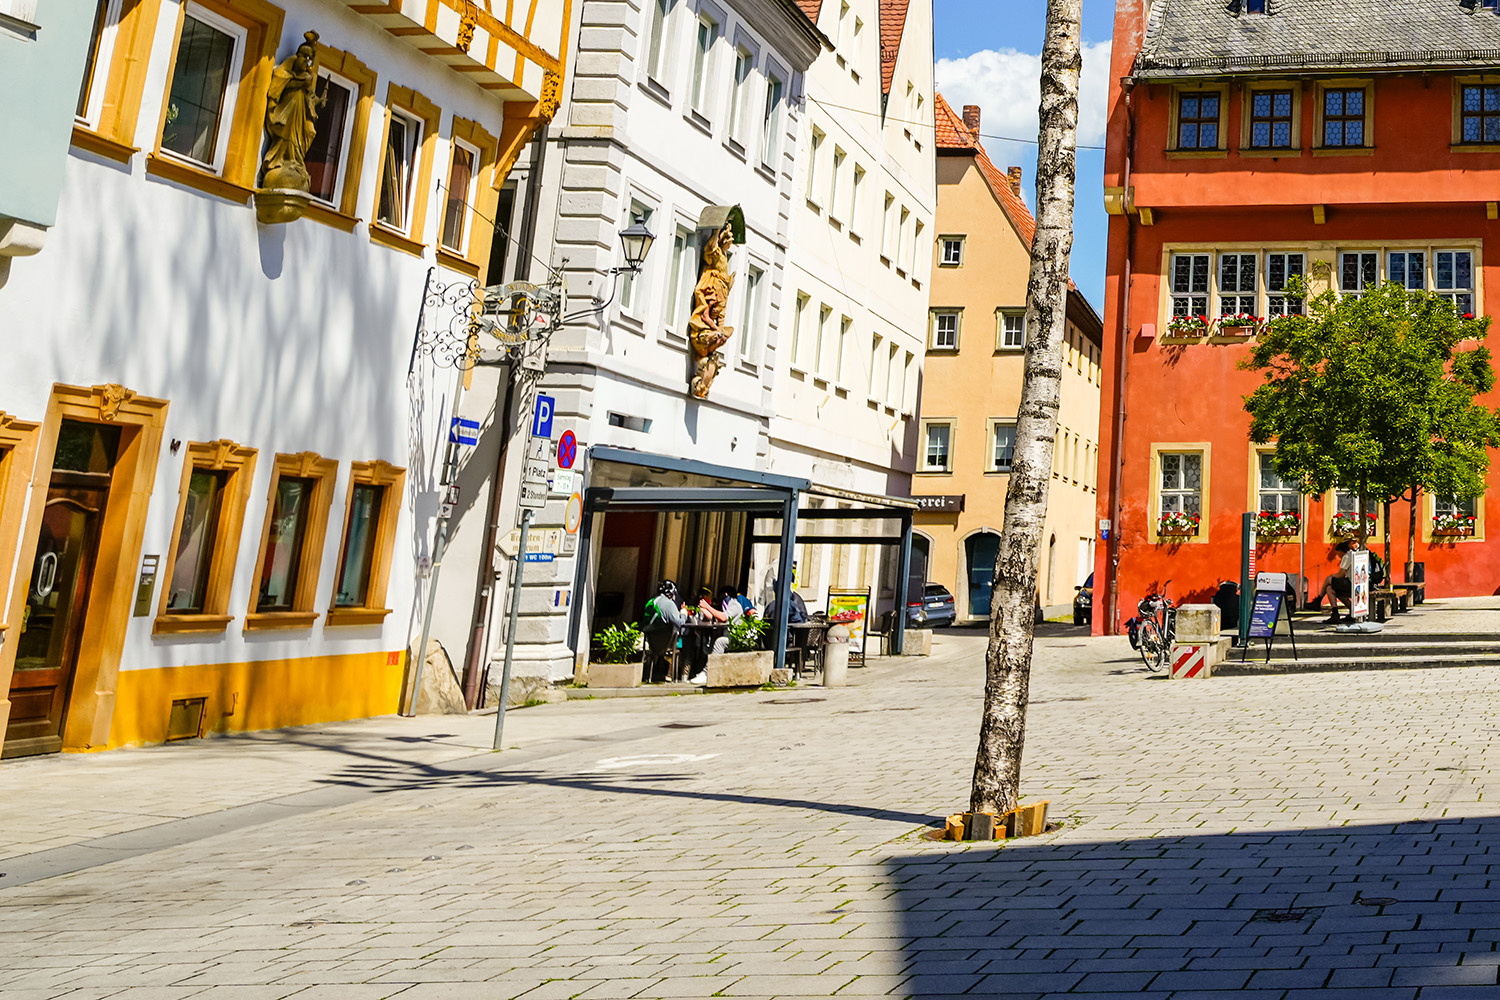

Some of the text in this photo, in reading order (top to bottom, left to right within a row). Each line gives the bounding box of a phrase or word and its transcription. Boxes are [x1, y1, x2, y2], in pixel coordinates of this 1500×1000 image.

[537, 401, 551, 435] P
[528, 466, 546, 478] 1 Platz
[526, 490, 531, 499] 2
[915, 496, 945, 508] erei
[538, 553, 552, 561] 100m
